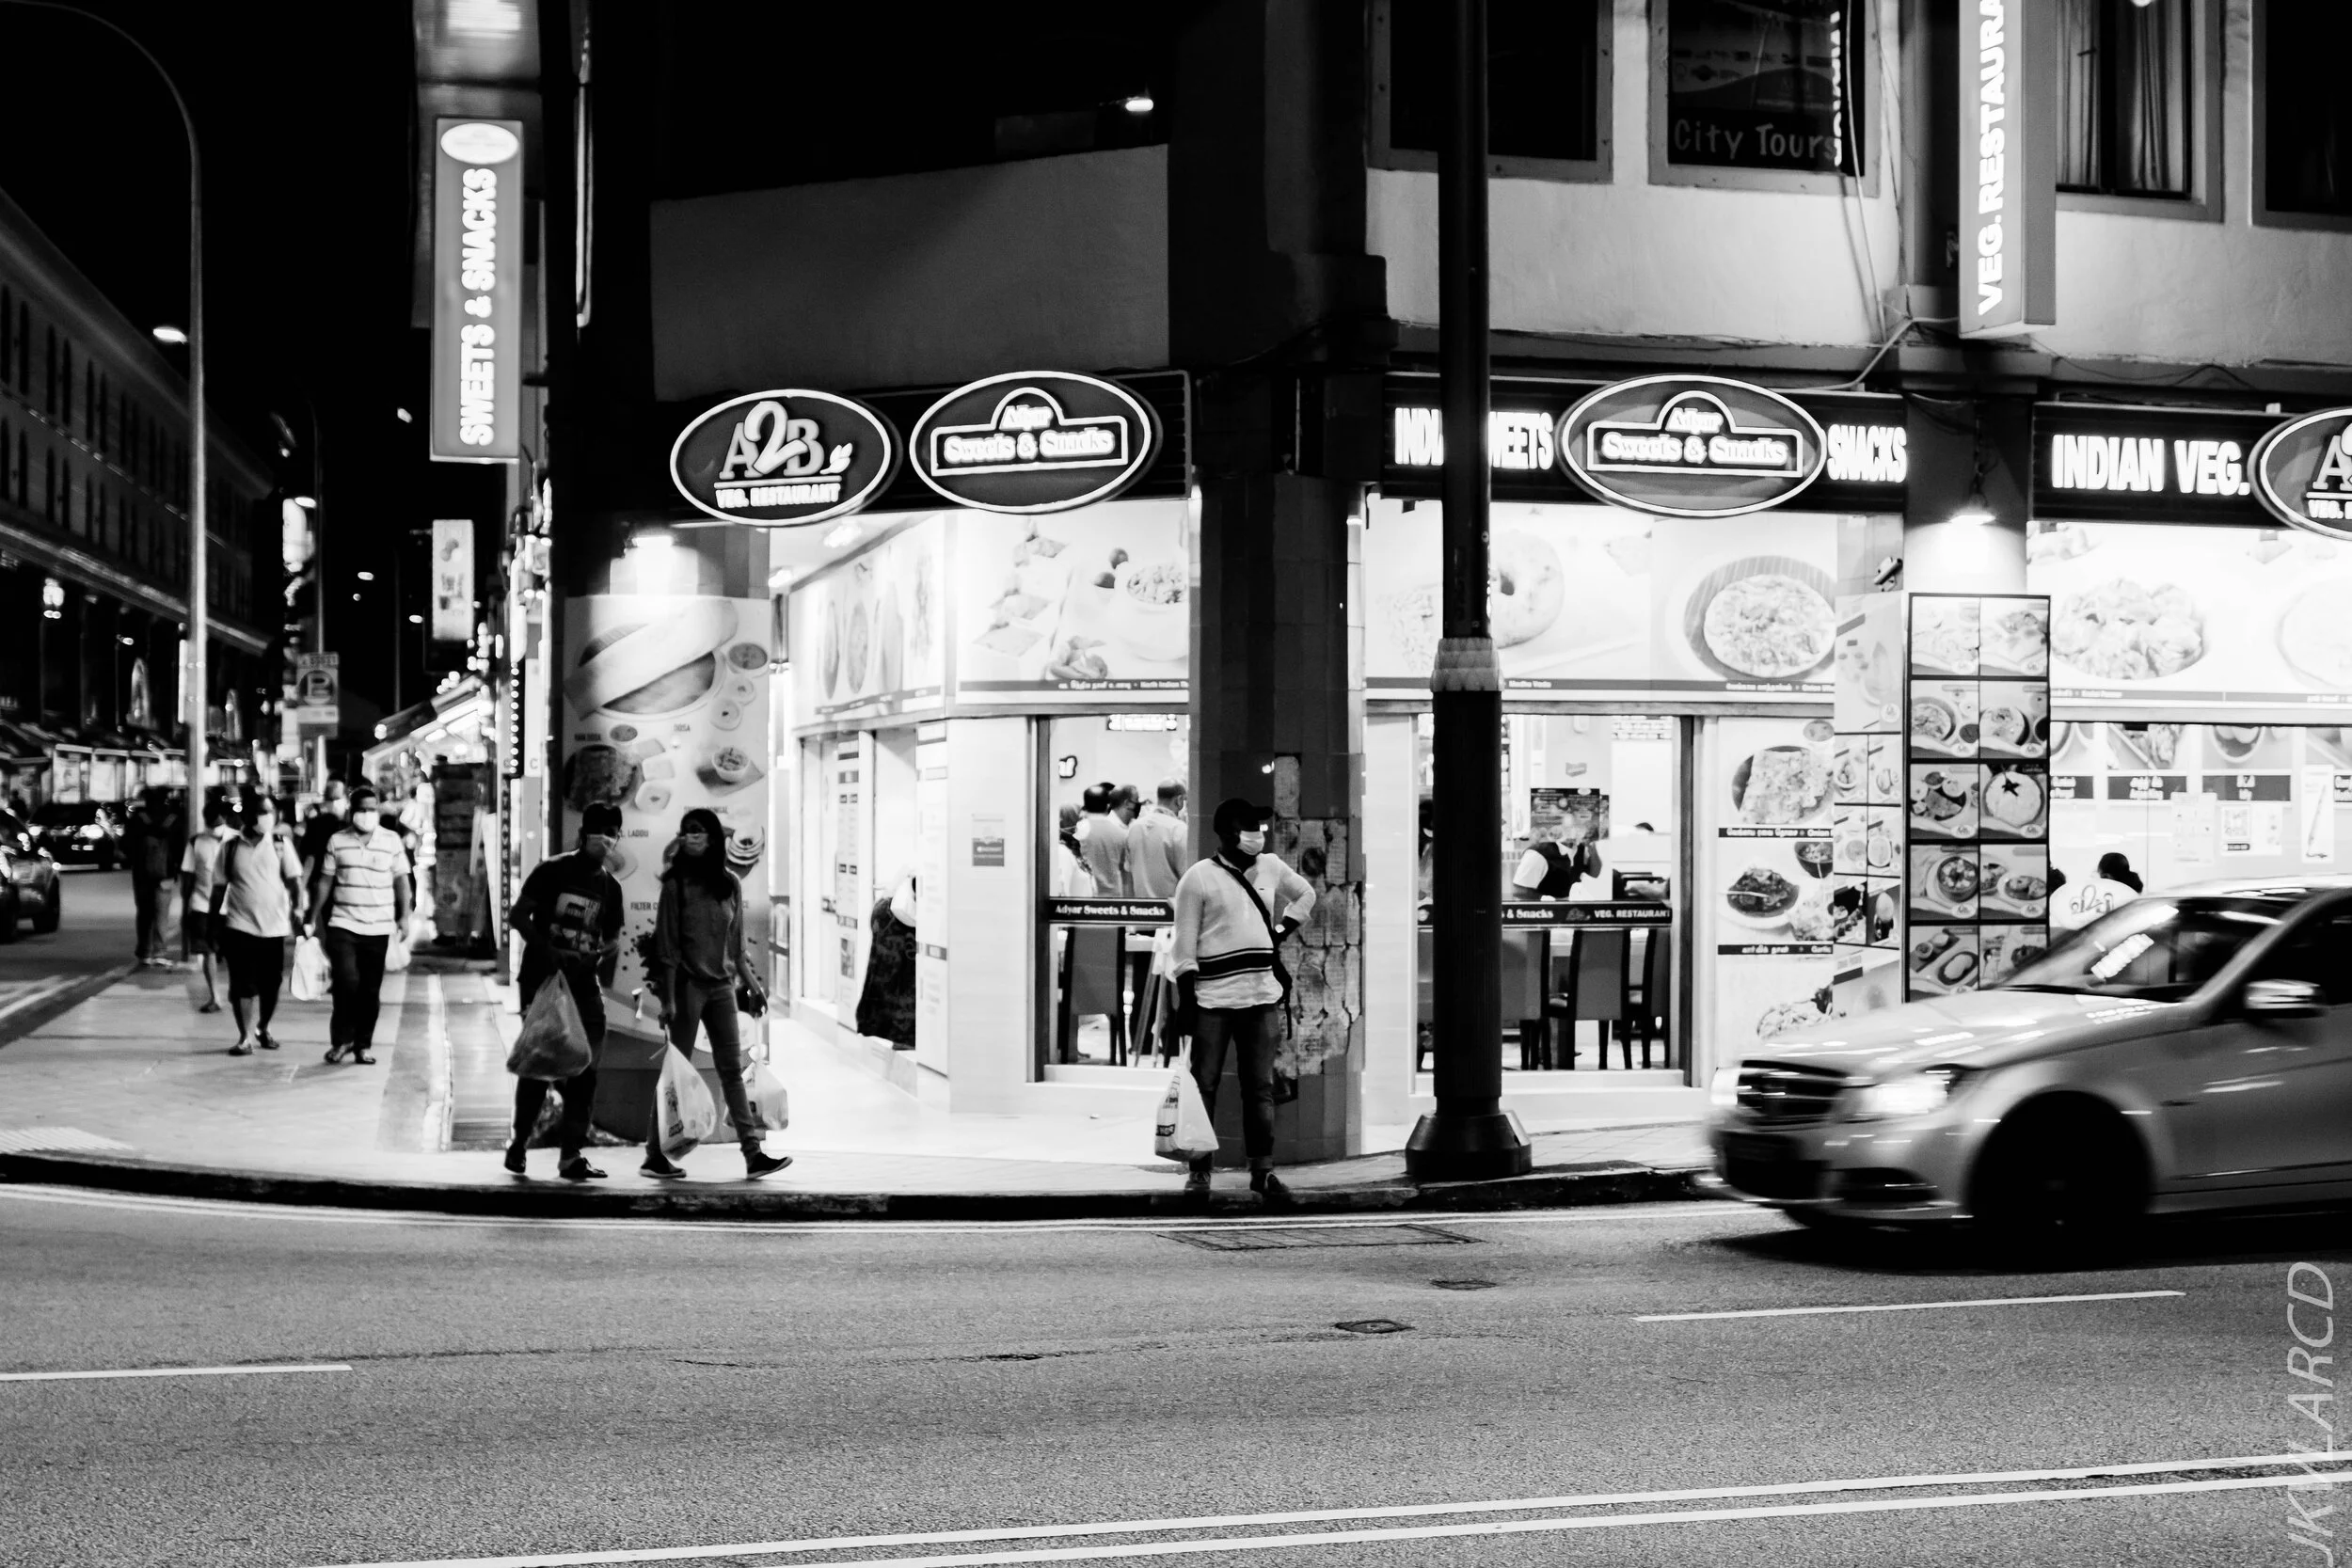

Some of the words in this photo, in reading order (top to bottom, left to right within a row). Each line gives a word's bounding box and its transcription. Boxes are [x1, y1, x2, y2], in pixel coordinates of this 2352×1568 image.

[1674, 119, 1743, 160] City
[1756, 123, 1837, 159] Tours
[461, 168, 497, 292] SNACKS
[464, 294, 492, 318] &
[460, 324, 495, 447] SWEETS
[719, 401, 825, 481] A2B
[945, 434, 1016, 462] Sweets
[1017, 432, 1038, 458] &
[1040, 427, 1114, 456] Snacks
[1394, 407, 1444, 467] INDI
[1488, 411, 1553, 470] WEETS
[1602, 432, 1682, 461] Sweets
[1684, 436, 1707, 463] &
[1708, 436, 1788, 465] Snacks
[1827, 423, 1907, 483] SNACKS
[2052, 434, 2164, 492] INDIAN
[2174, 439, 2250, 496] VEG.
[750, 483, 840, 507] RESTAURANT
[1055, 904, 1083, 916] Adyar
[1084, 904, 1119, 916] Sweets
[1120, 905, 1128, 915] &
[1129, 906, 1166, 917] Snacks
[1506, 909, 1515, 919] &
[1516, 909, 1554, 919] Snacks
[1594, 910, 1614, 919] VEG.
